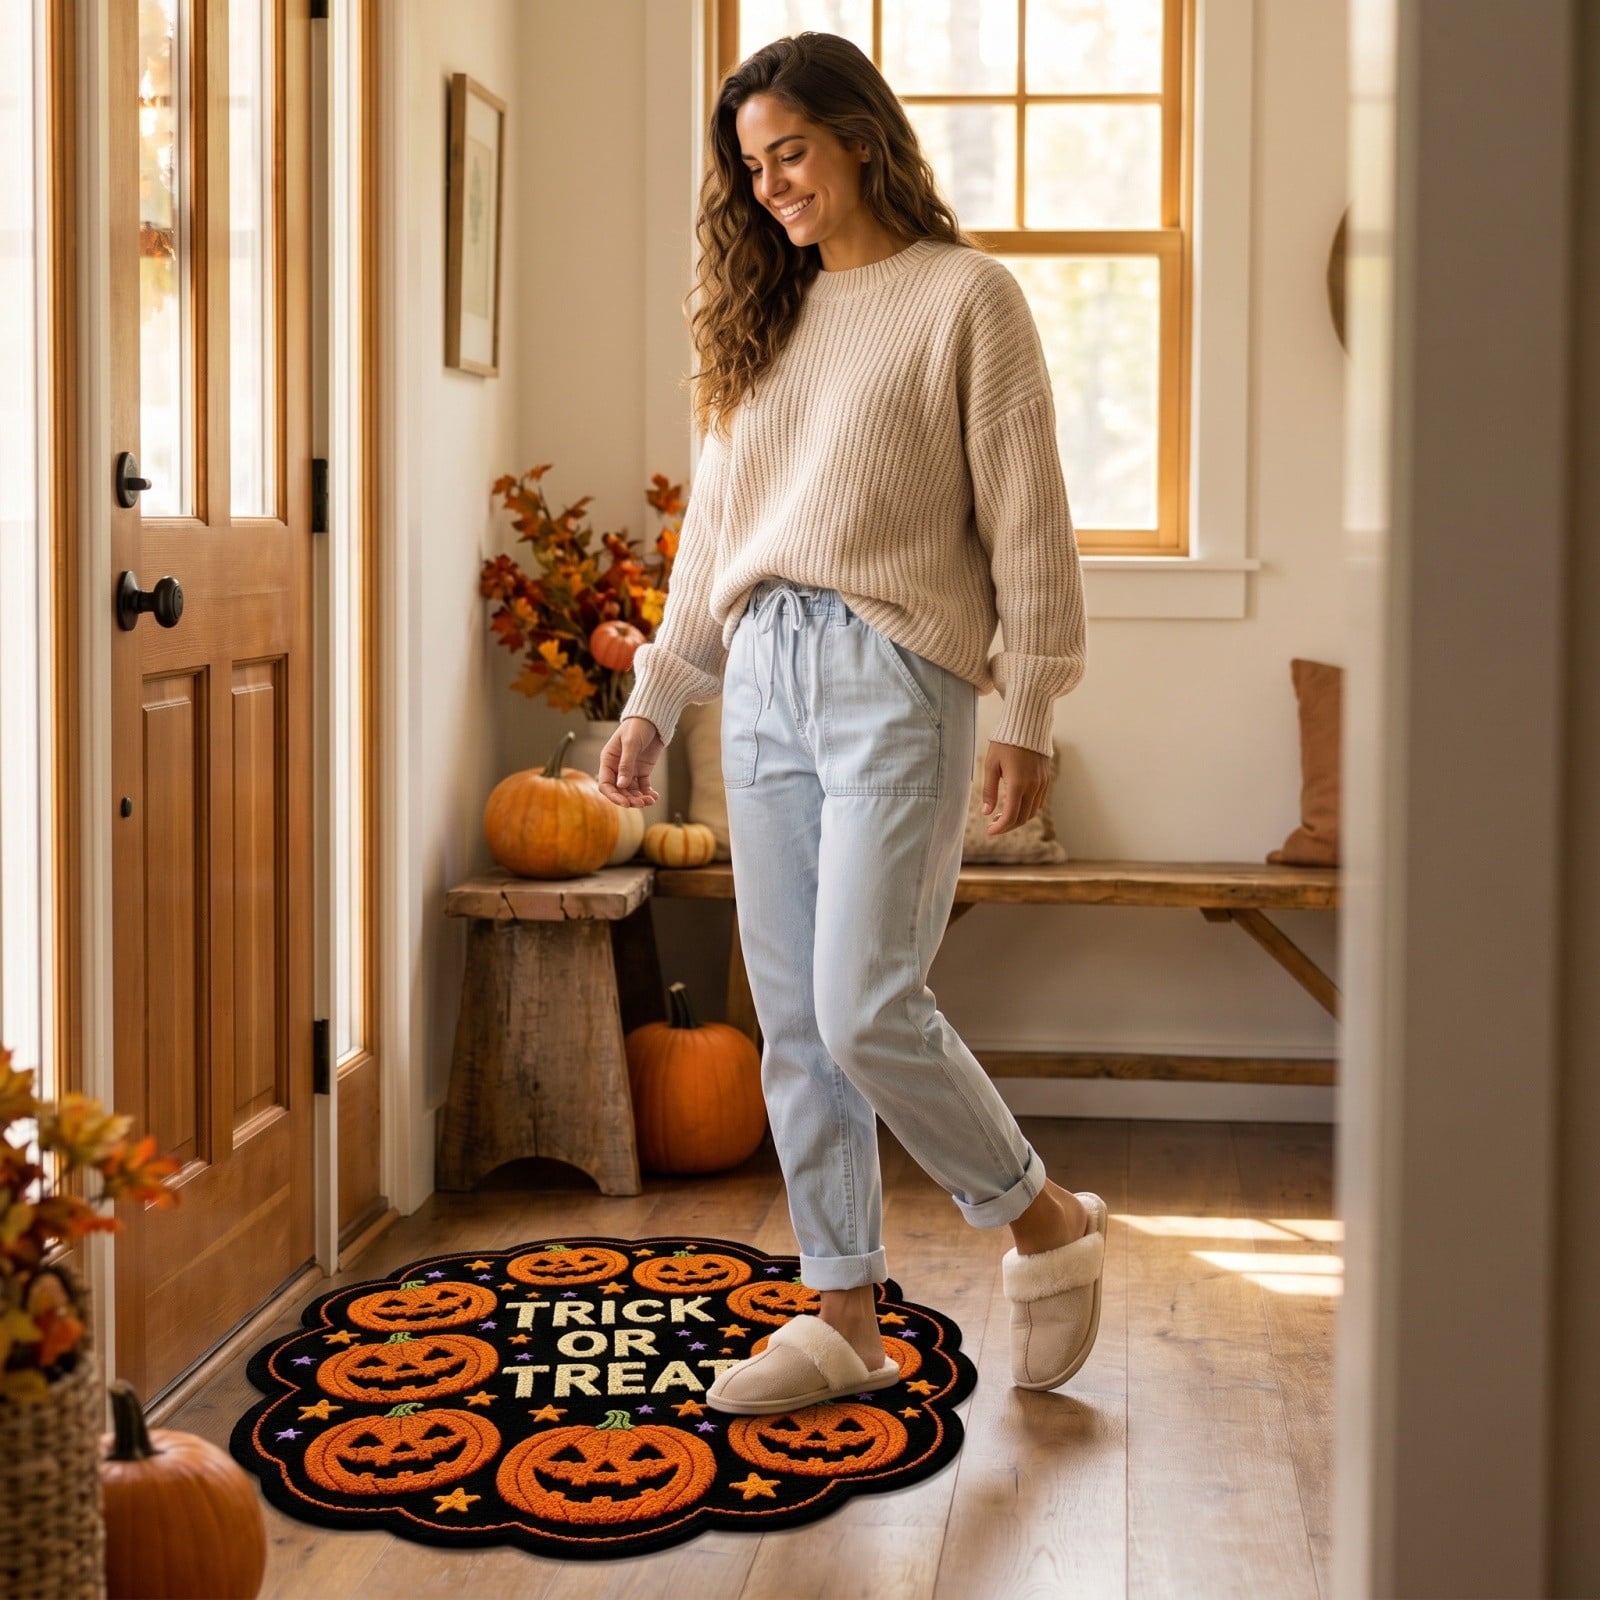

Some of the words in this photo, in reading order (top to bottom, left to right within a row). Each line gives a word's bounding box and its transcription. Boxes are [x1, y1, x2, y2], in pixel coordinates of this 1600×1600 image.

[505, 1296, 715, 1329] TRICK
[557, 1329, 660, 1358] OR
[502, 1359, 741, 1398] TREAT
